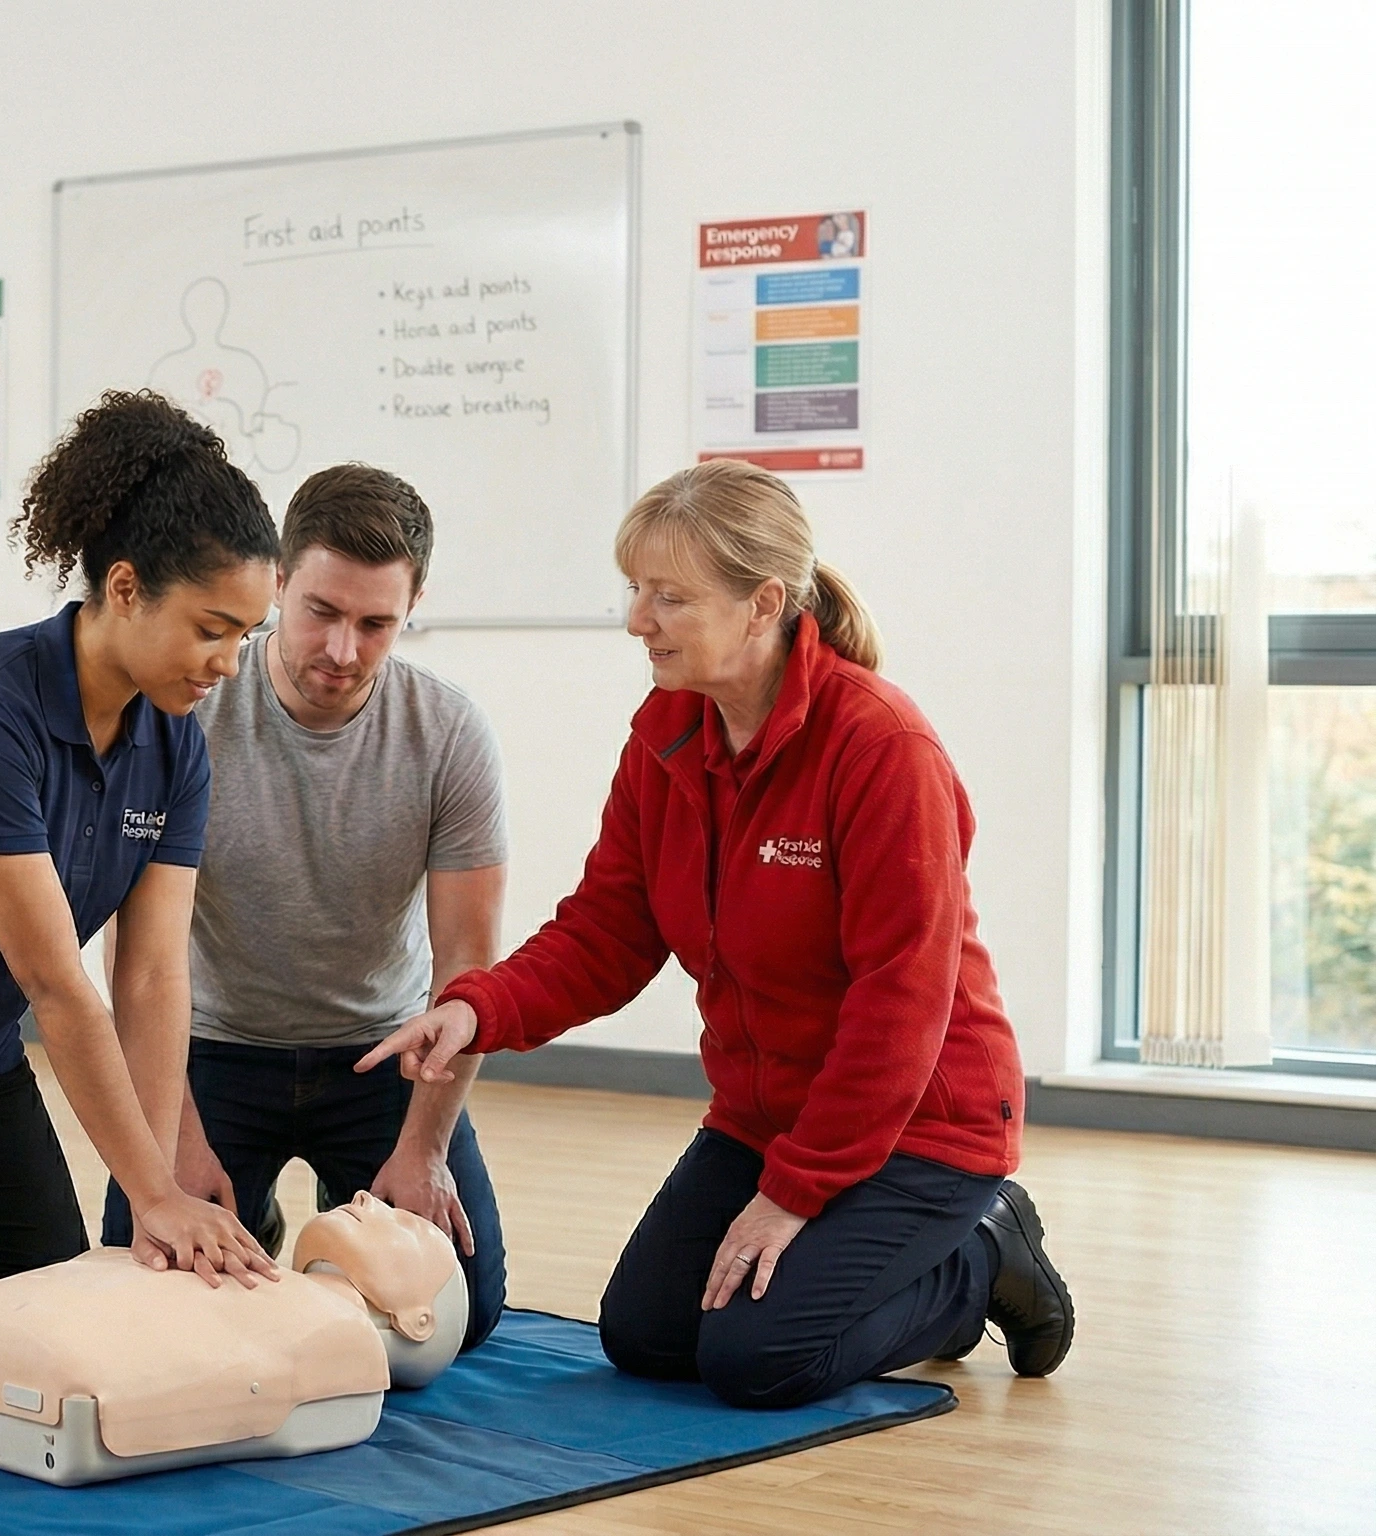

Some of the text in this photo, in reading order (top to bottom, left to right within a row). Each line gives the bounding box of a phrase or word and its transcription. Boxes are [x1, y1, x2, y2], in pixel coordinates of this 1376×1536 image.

[244, 206, 425, 249] First aid points
[706, 224, 799, 245] Emergency
[706, 244, 782, 264] response
[479, 272, 532, 303] points
[486, 310, 538, 343] points
[461, 390, 551, 427] breathing
